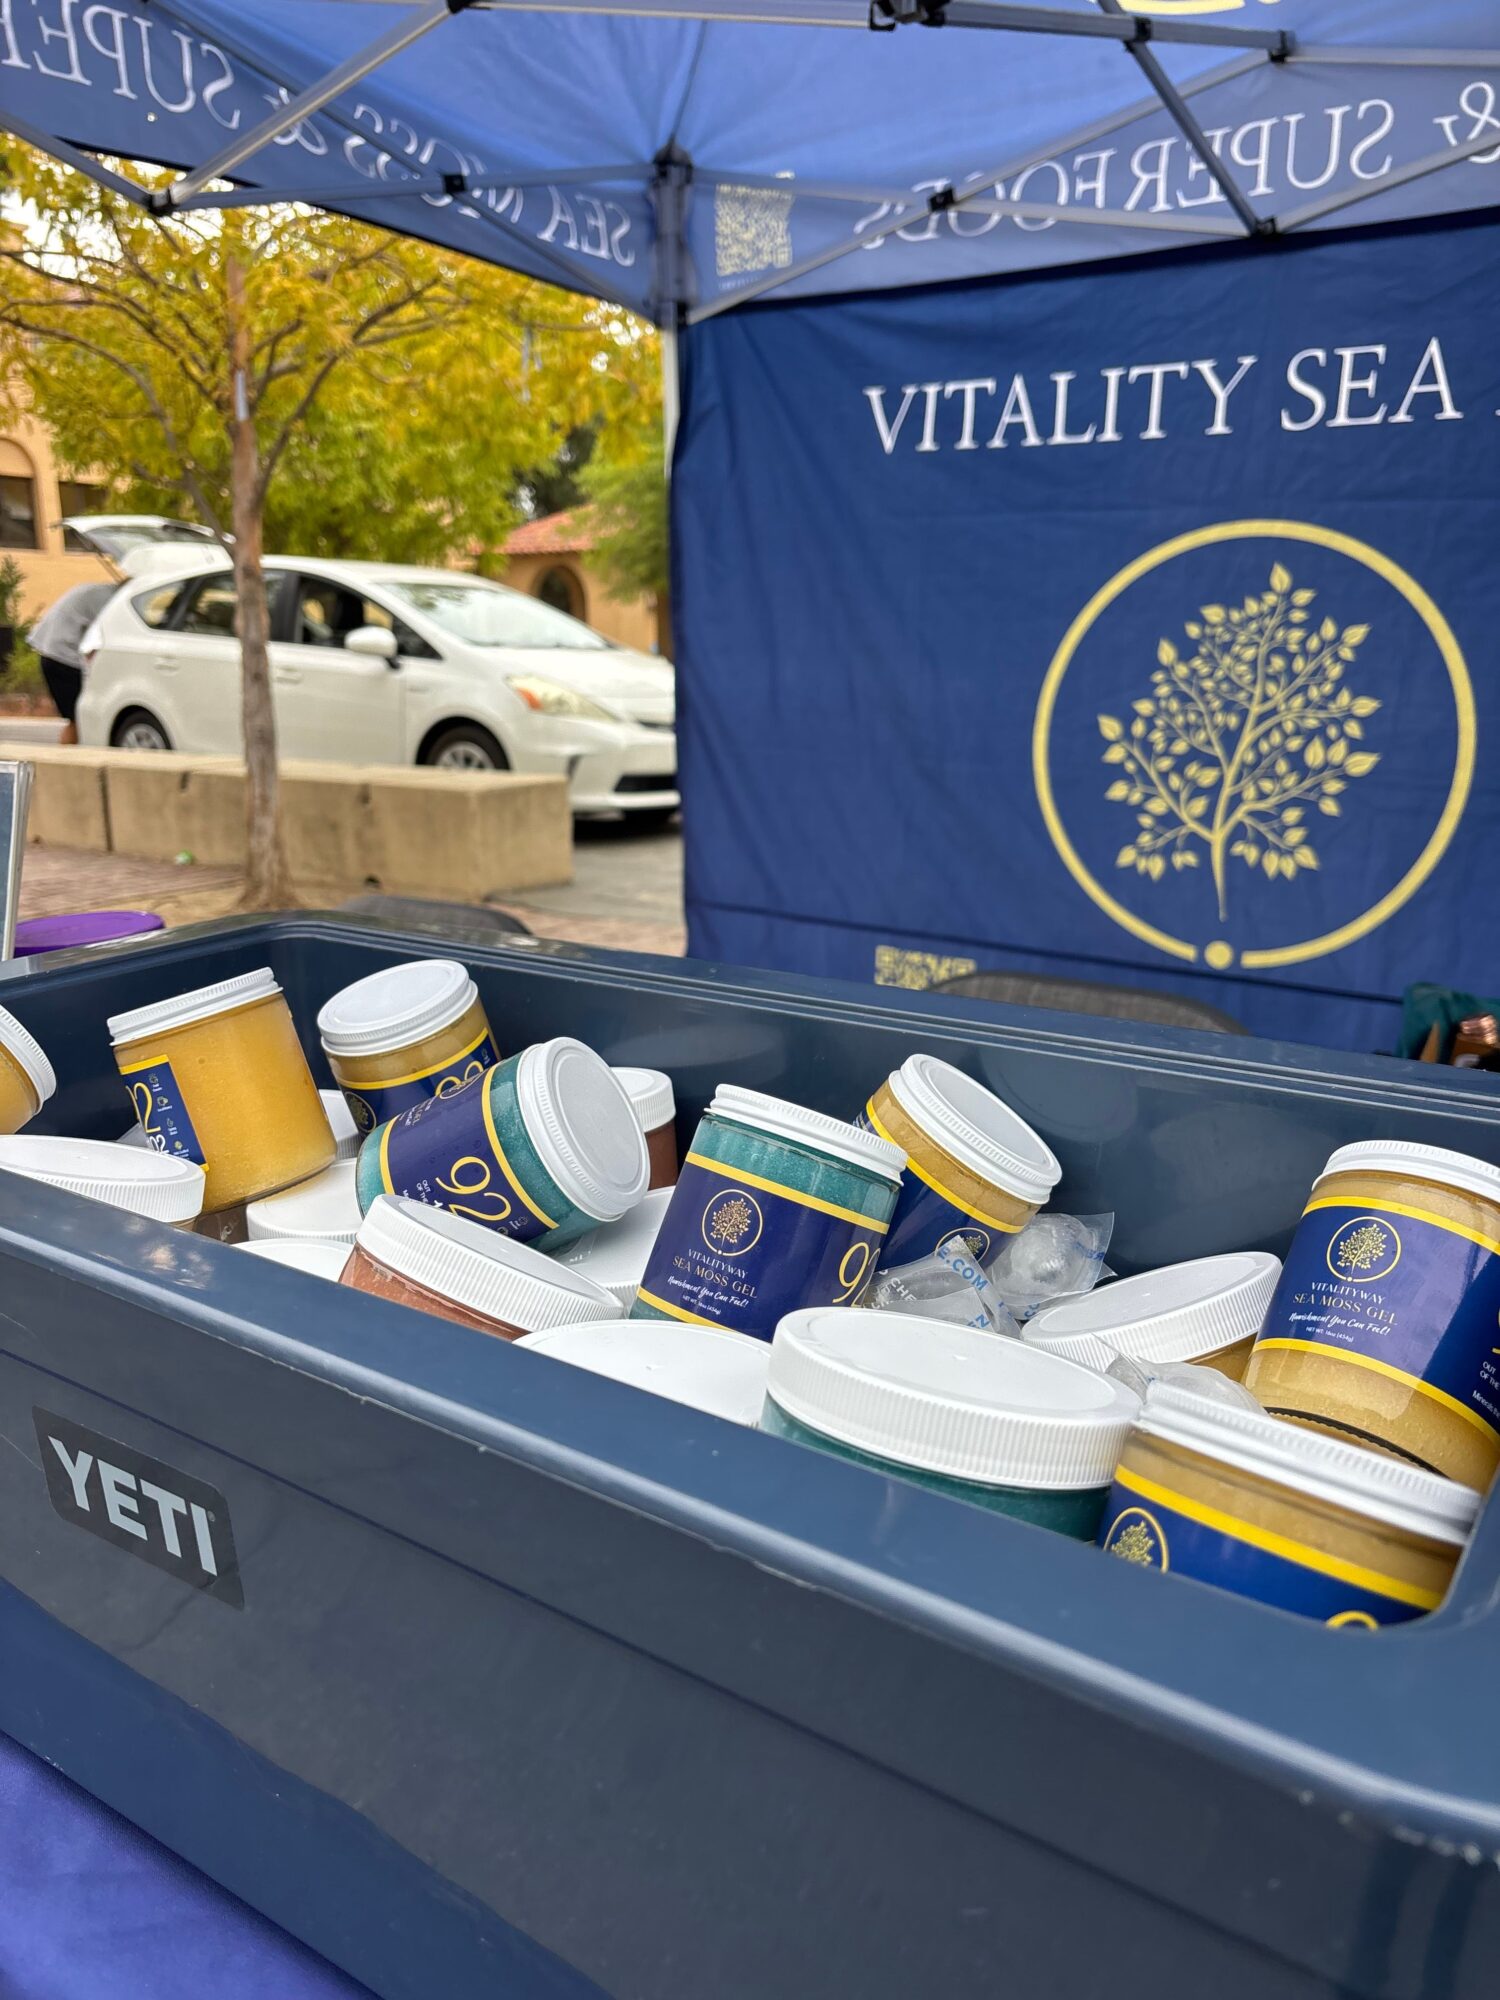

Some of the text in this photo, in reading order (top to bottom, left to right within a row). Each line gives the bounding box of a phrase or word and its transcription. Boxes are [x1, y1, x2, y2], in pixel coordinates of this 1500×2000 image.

[863, 337, 1464, 455] VITALITY SEA
[672, 1255, 758, 1299] SEA MOSS GEL
[688, 1248, 748, 1279] VITALITYWAY
[698, 1287, 714, 1299] You
[713, 1291, 728, 1302] Can
[729, 1295, 749, 1308] Feel!
[1311, 1281, 1385, 1304] VITALITYWAY
[1293, 1293, 1398, 1326] SEA MOSS GEL
[1327, 1315, 1346, 1328] You
[1347, 1318, 1365, 1330] Can
[1366, 1322, 1391, 1336] Feel!
[1479, 1371, 1489, 1380] OF
[1482, 1361, 1497, 1375] OUT
[47, 1435, 218, 1577] YETI
